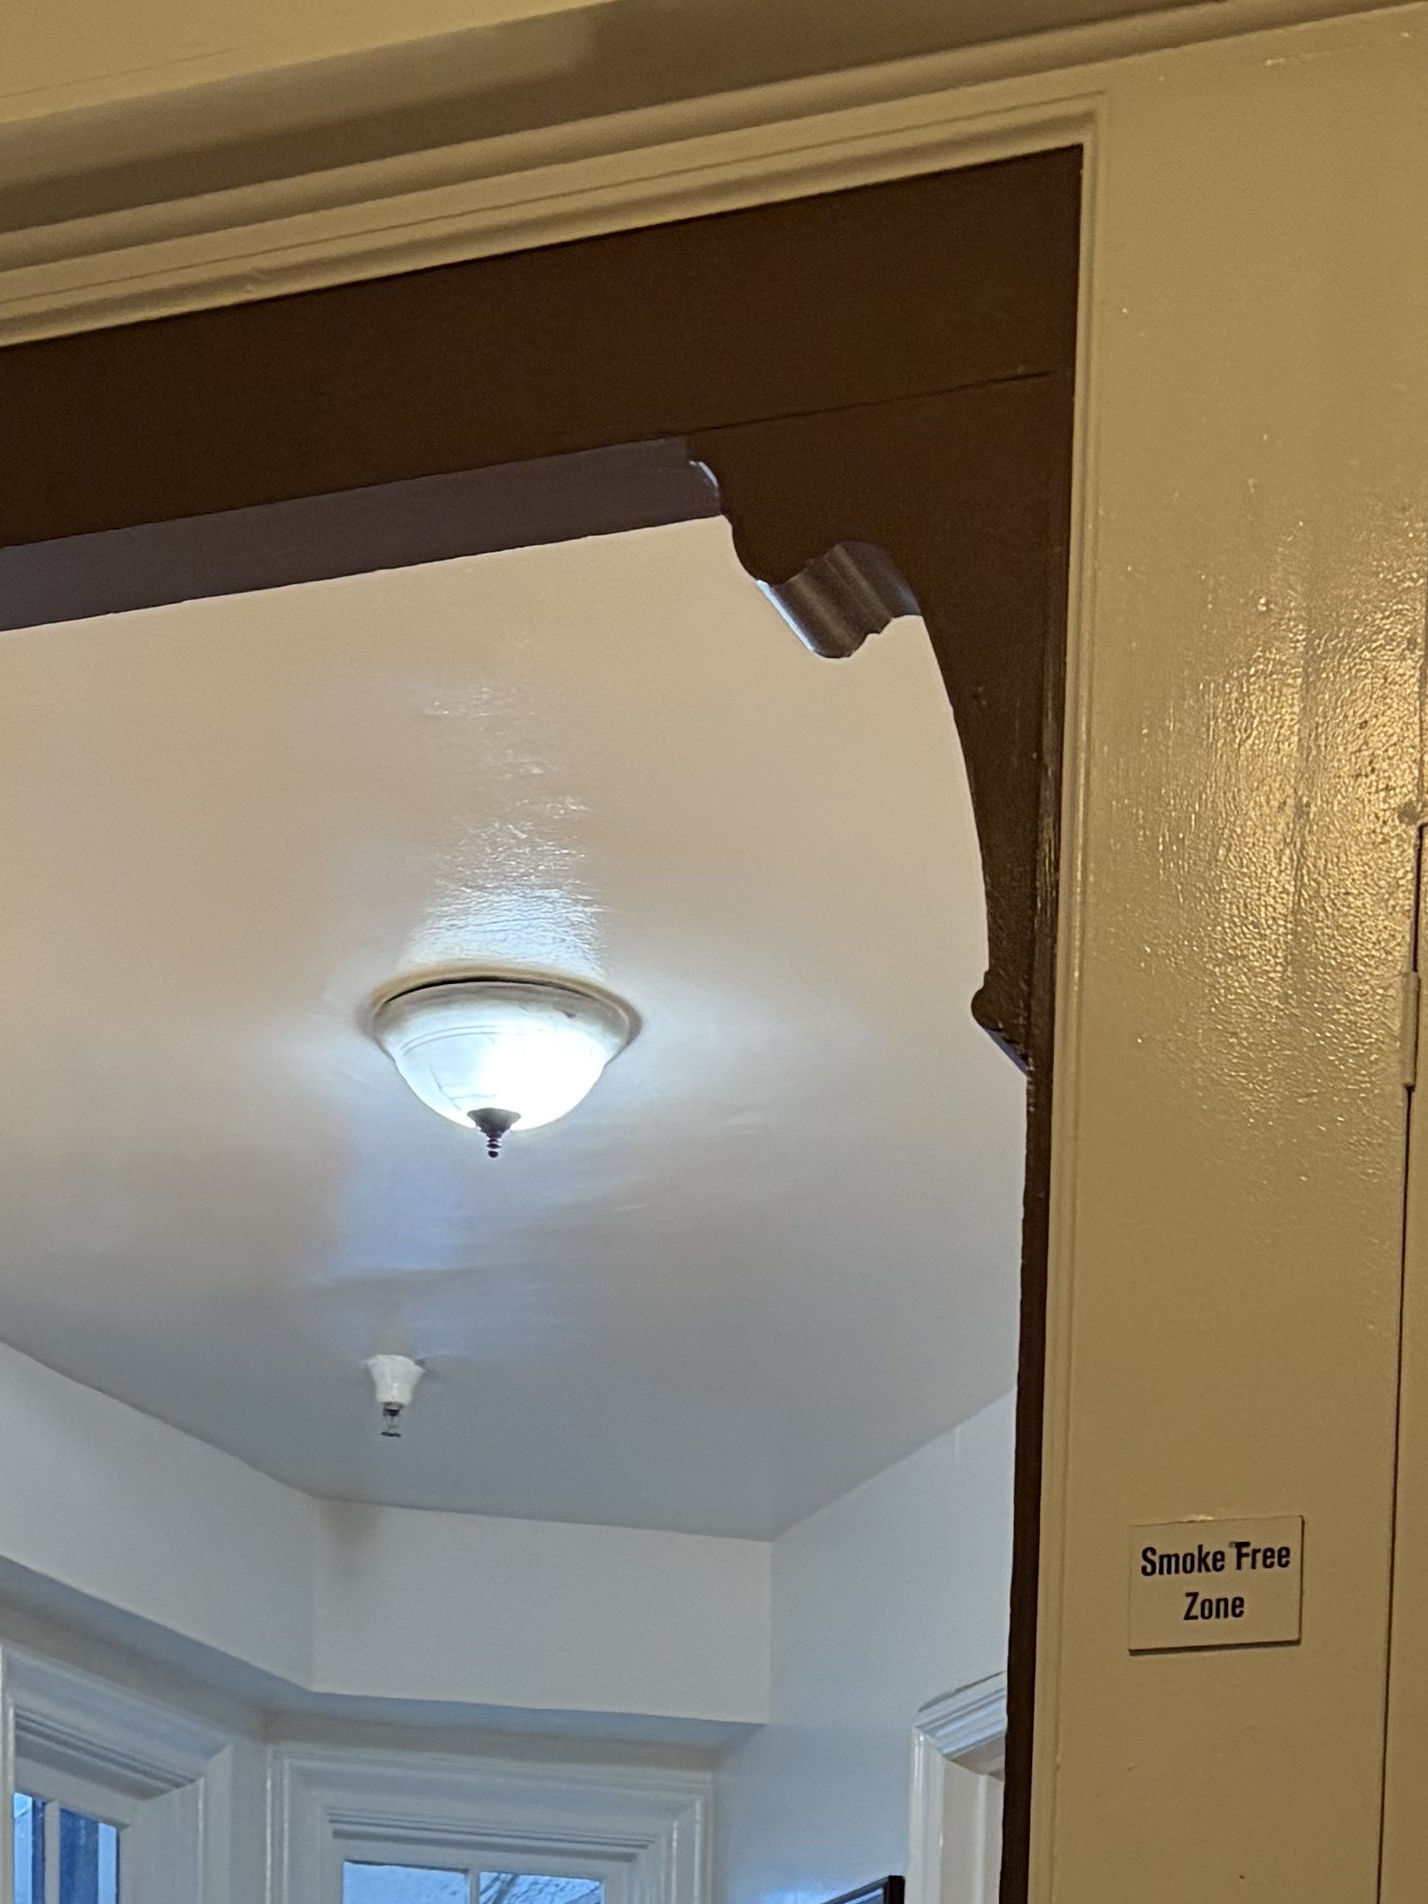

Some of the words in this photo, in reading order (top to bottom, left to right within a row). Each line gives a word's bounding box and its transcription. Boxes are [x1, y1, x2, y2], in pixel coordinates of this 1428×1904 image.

[1141, 1544, 1226, 1576] Smoke
[1231, 1541, 1291, 1570] Free
[1183, 1592, 1245, 1620] Zone
